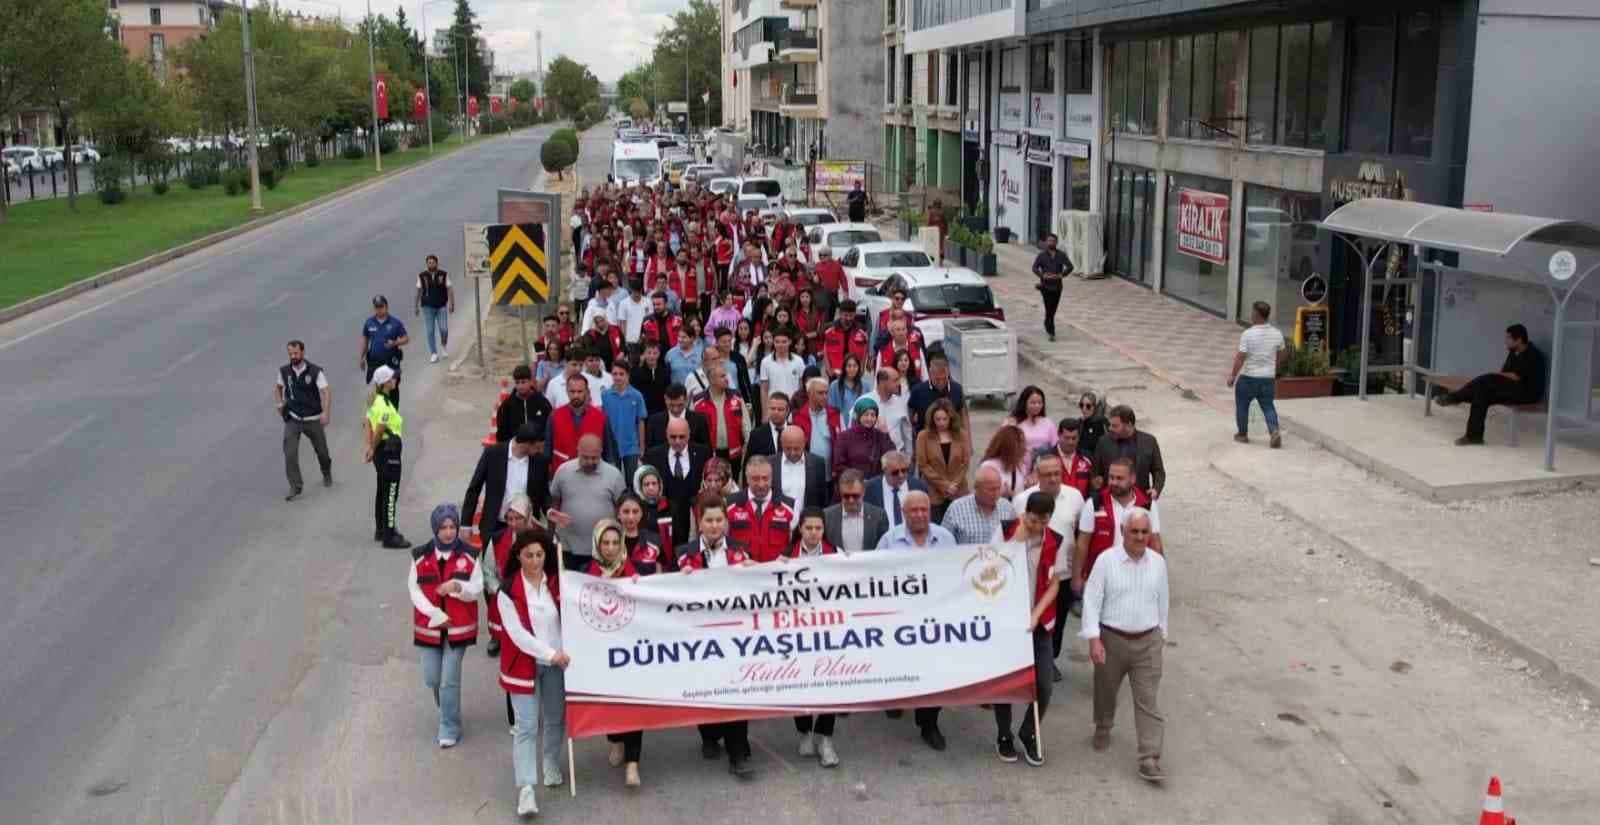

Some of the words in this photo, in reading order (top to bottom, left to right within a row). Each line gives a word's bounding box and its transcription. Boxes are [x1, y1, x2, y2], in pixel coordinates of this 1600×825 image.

[771, 567, 818, 587] T.C.
[665, 587, 811, 613] ADIYAMAN
[817, 573, 928, 601] VALİLİĞİ
[751, 611, 760, 630] 1
[773, 607, 845, 629] Ekim
[608, 637, 725, 669] DÜNYA
[731, 627, 884, 660] YAŞLILAR
[894, 615, 992, 646] GÜNÜ
[738, 656, 801, 682] Kutlu
[813, 654, 873, 678] Olsun
